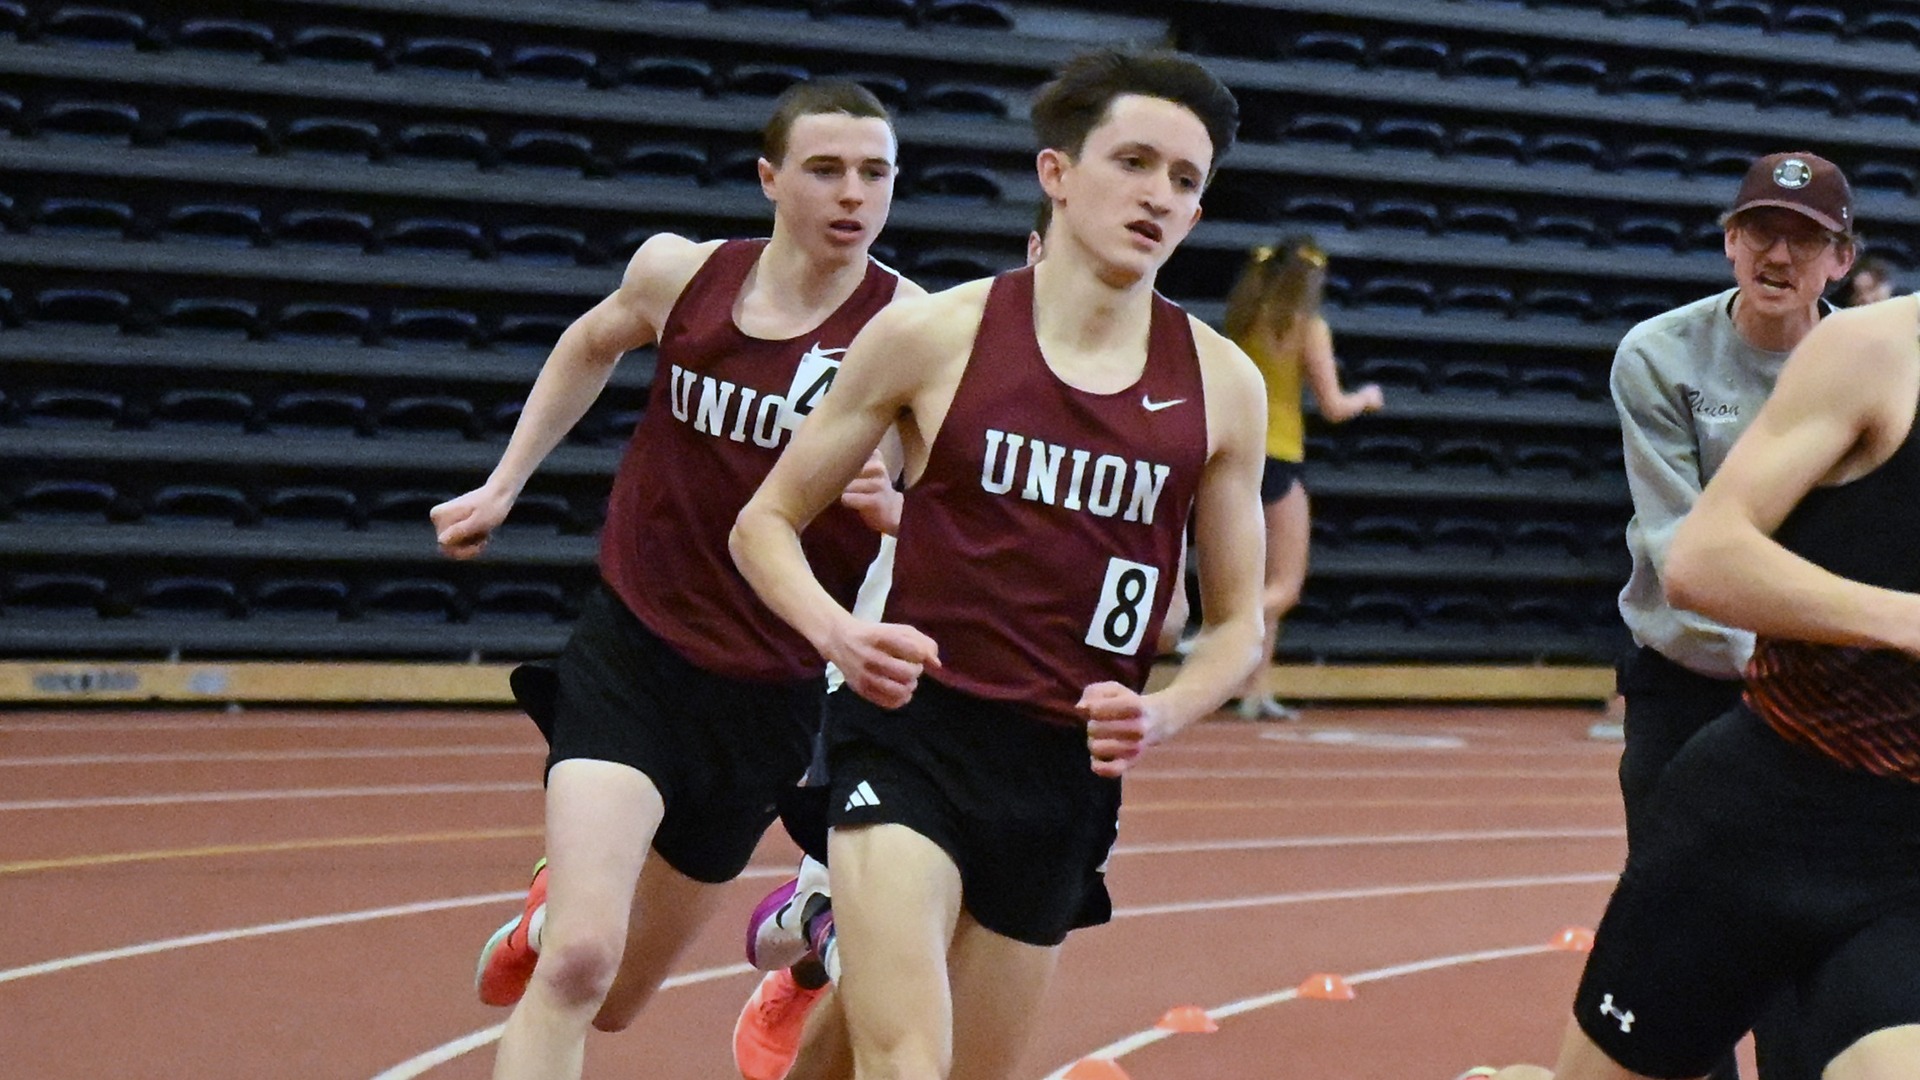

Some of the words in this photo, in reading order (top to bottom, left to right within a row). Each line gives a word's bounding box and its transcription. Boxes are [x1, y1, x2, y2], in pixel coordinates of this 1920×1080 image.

[671, 364, 790, 449] UNIO
[981, 429, 1170, 525] UNION
[1103, 568, 1147, 648] 8
